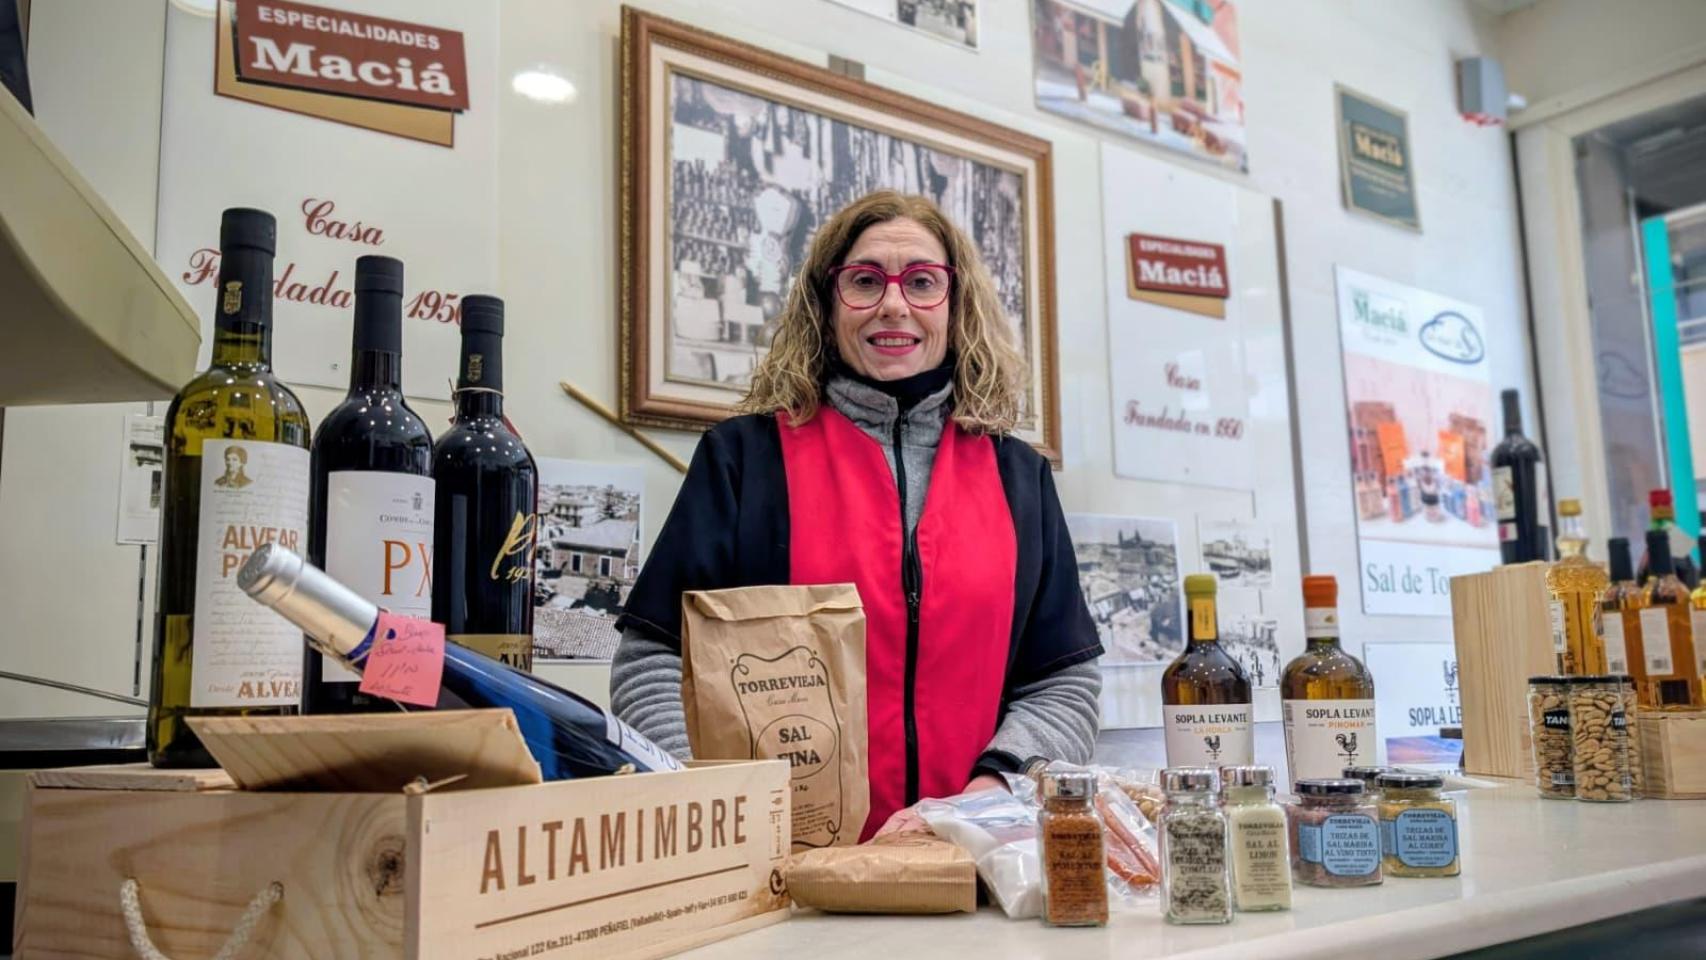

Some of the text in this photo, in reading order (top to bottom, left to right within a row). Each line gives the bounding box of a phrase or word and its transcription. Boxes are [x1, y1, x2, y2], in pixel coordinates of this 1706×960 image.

[257, 5, 441, 50] ESPECIALIDADES
[249, 36, 455, 96] Maciá
[301, 198, 384, 246] Casa
[183, 247, 352, 310] Fdada
[1137, 258, 1225, 289] Maciá
[1165, 362, 1201, 391] Casa
[1124, 400, 1191, 433] Fundada
[381, 538, 433, 597] PX
[1366, 563, 1396, 592] Sal
[1401, 565, 1422, 594] de
[738, 674, 826, 695] TORREVIEJA
[1175, 713, 1248, 724] SOPLA LEVANTE
[1306, 709, 1340, 719] SOPLA
[1409, 706, 1447, 727] SOPLA
[778, 725, 812, 744] SAL
[479, 795, 748, 894] ALTAMIMBRE
[1267, 840, 1280, 848] AL
[600, 919, 629, 937] PEÑAFIEL
